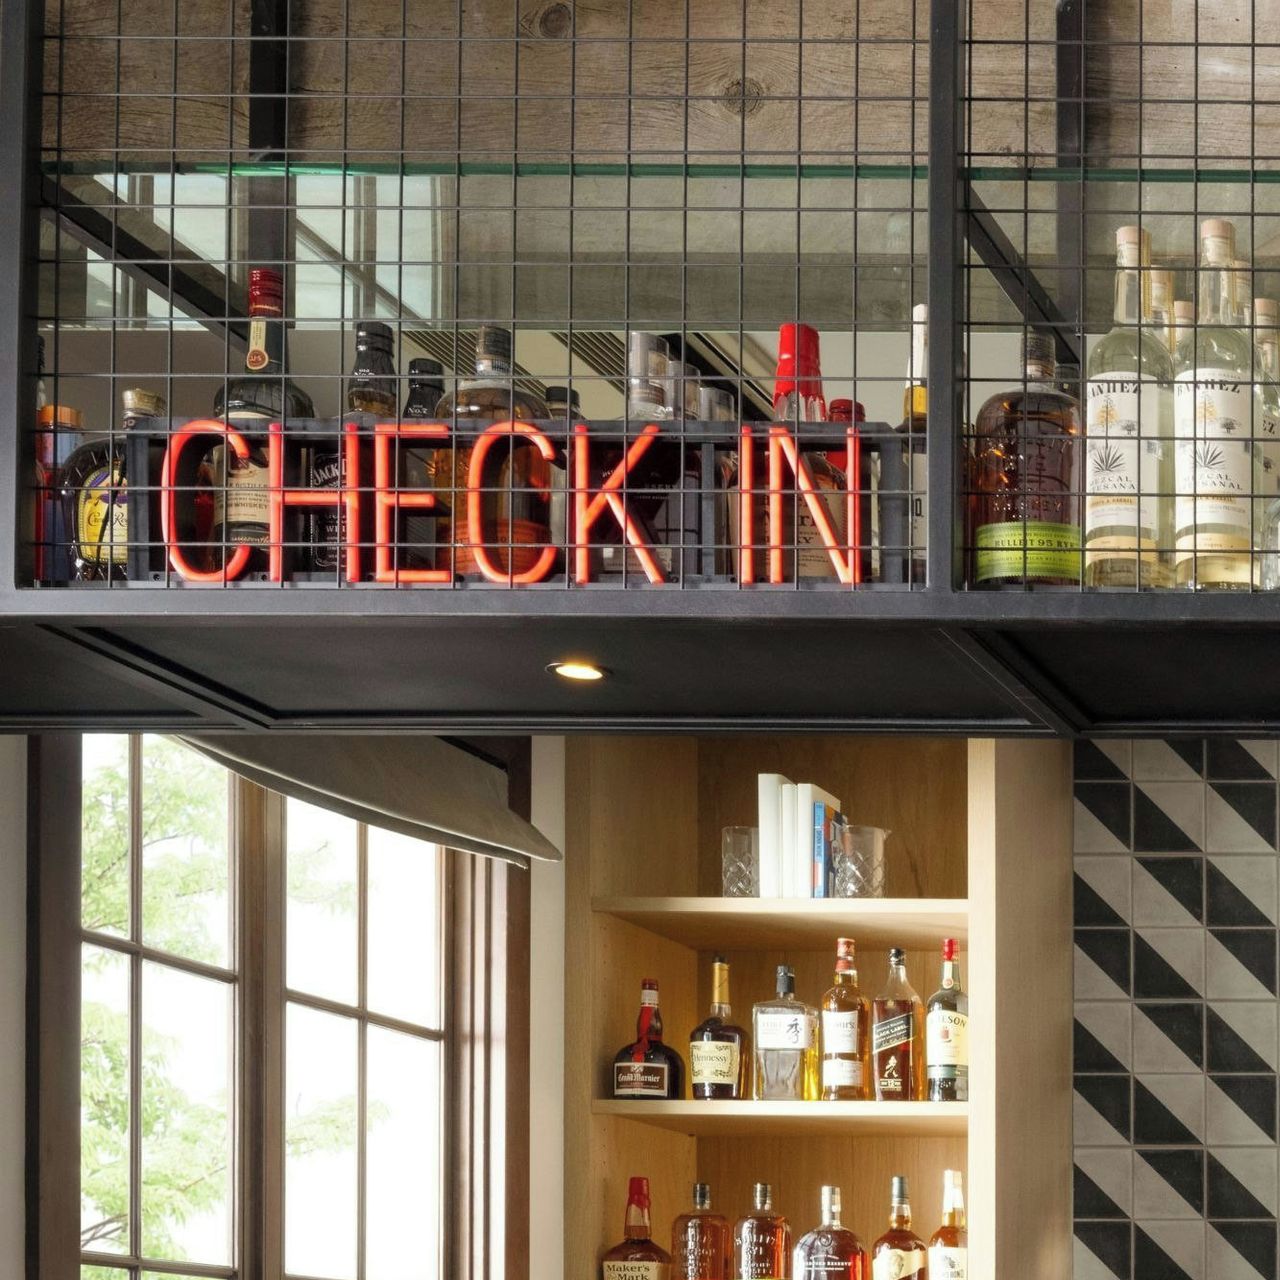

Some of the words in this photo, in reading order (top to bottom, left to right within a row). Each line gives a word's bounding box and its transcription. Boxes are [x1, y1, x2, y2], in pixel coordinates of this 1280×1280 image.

[1088, 381, 1142, 398] ANHEZ
[162, 419, 664, 584] CHECK
[741, 424, 862, 584] IN
[994, 538, 1034, 547] BULLET
[1037, 539, 1053, 547] 95
[693, 1053, 728, 1064] Hennessy
[634, 1071, 661, 1083] Marnier
[606, 1263, 651, 1273] Maker's
